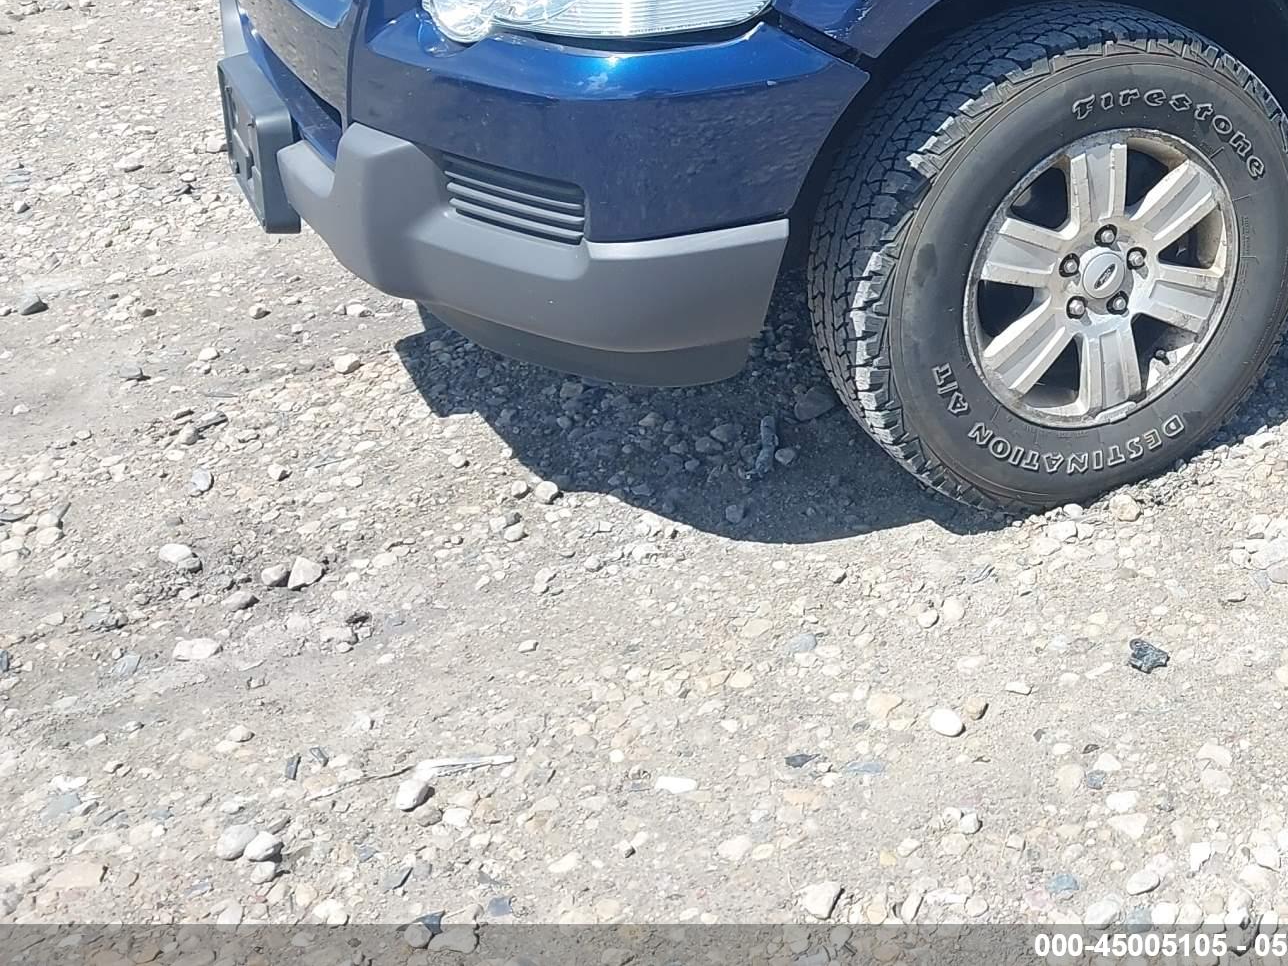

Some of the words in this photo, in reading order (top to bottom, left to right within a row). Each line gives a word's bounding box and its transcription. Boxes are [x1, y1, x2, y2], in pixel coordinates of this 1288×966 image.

[1072, 87, 1266, 180] Firestone
[931, 363, 970, 416] A/T
[967, 414, 1186, 475] DESTINATION
